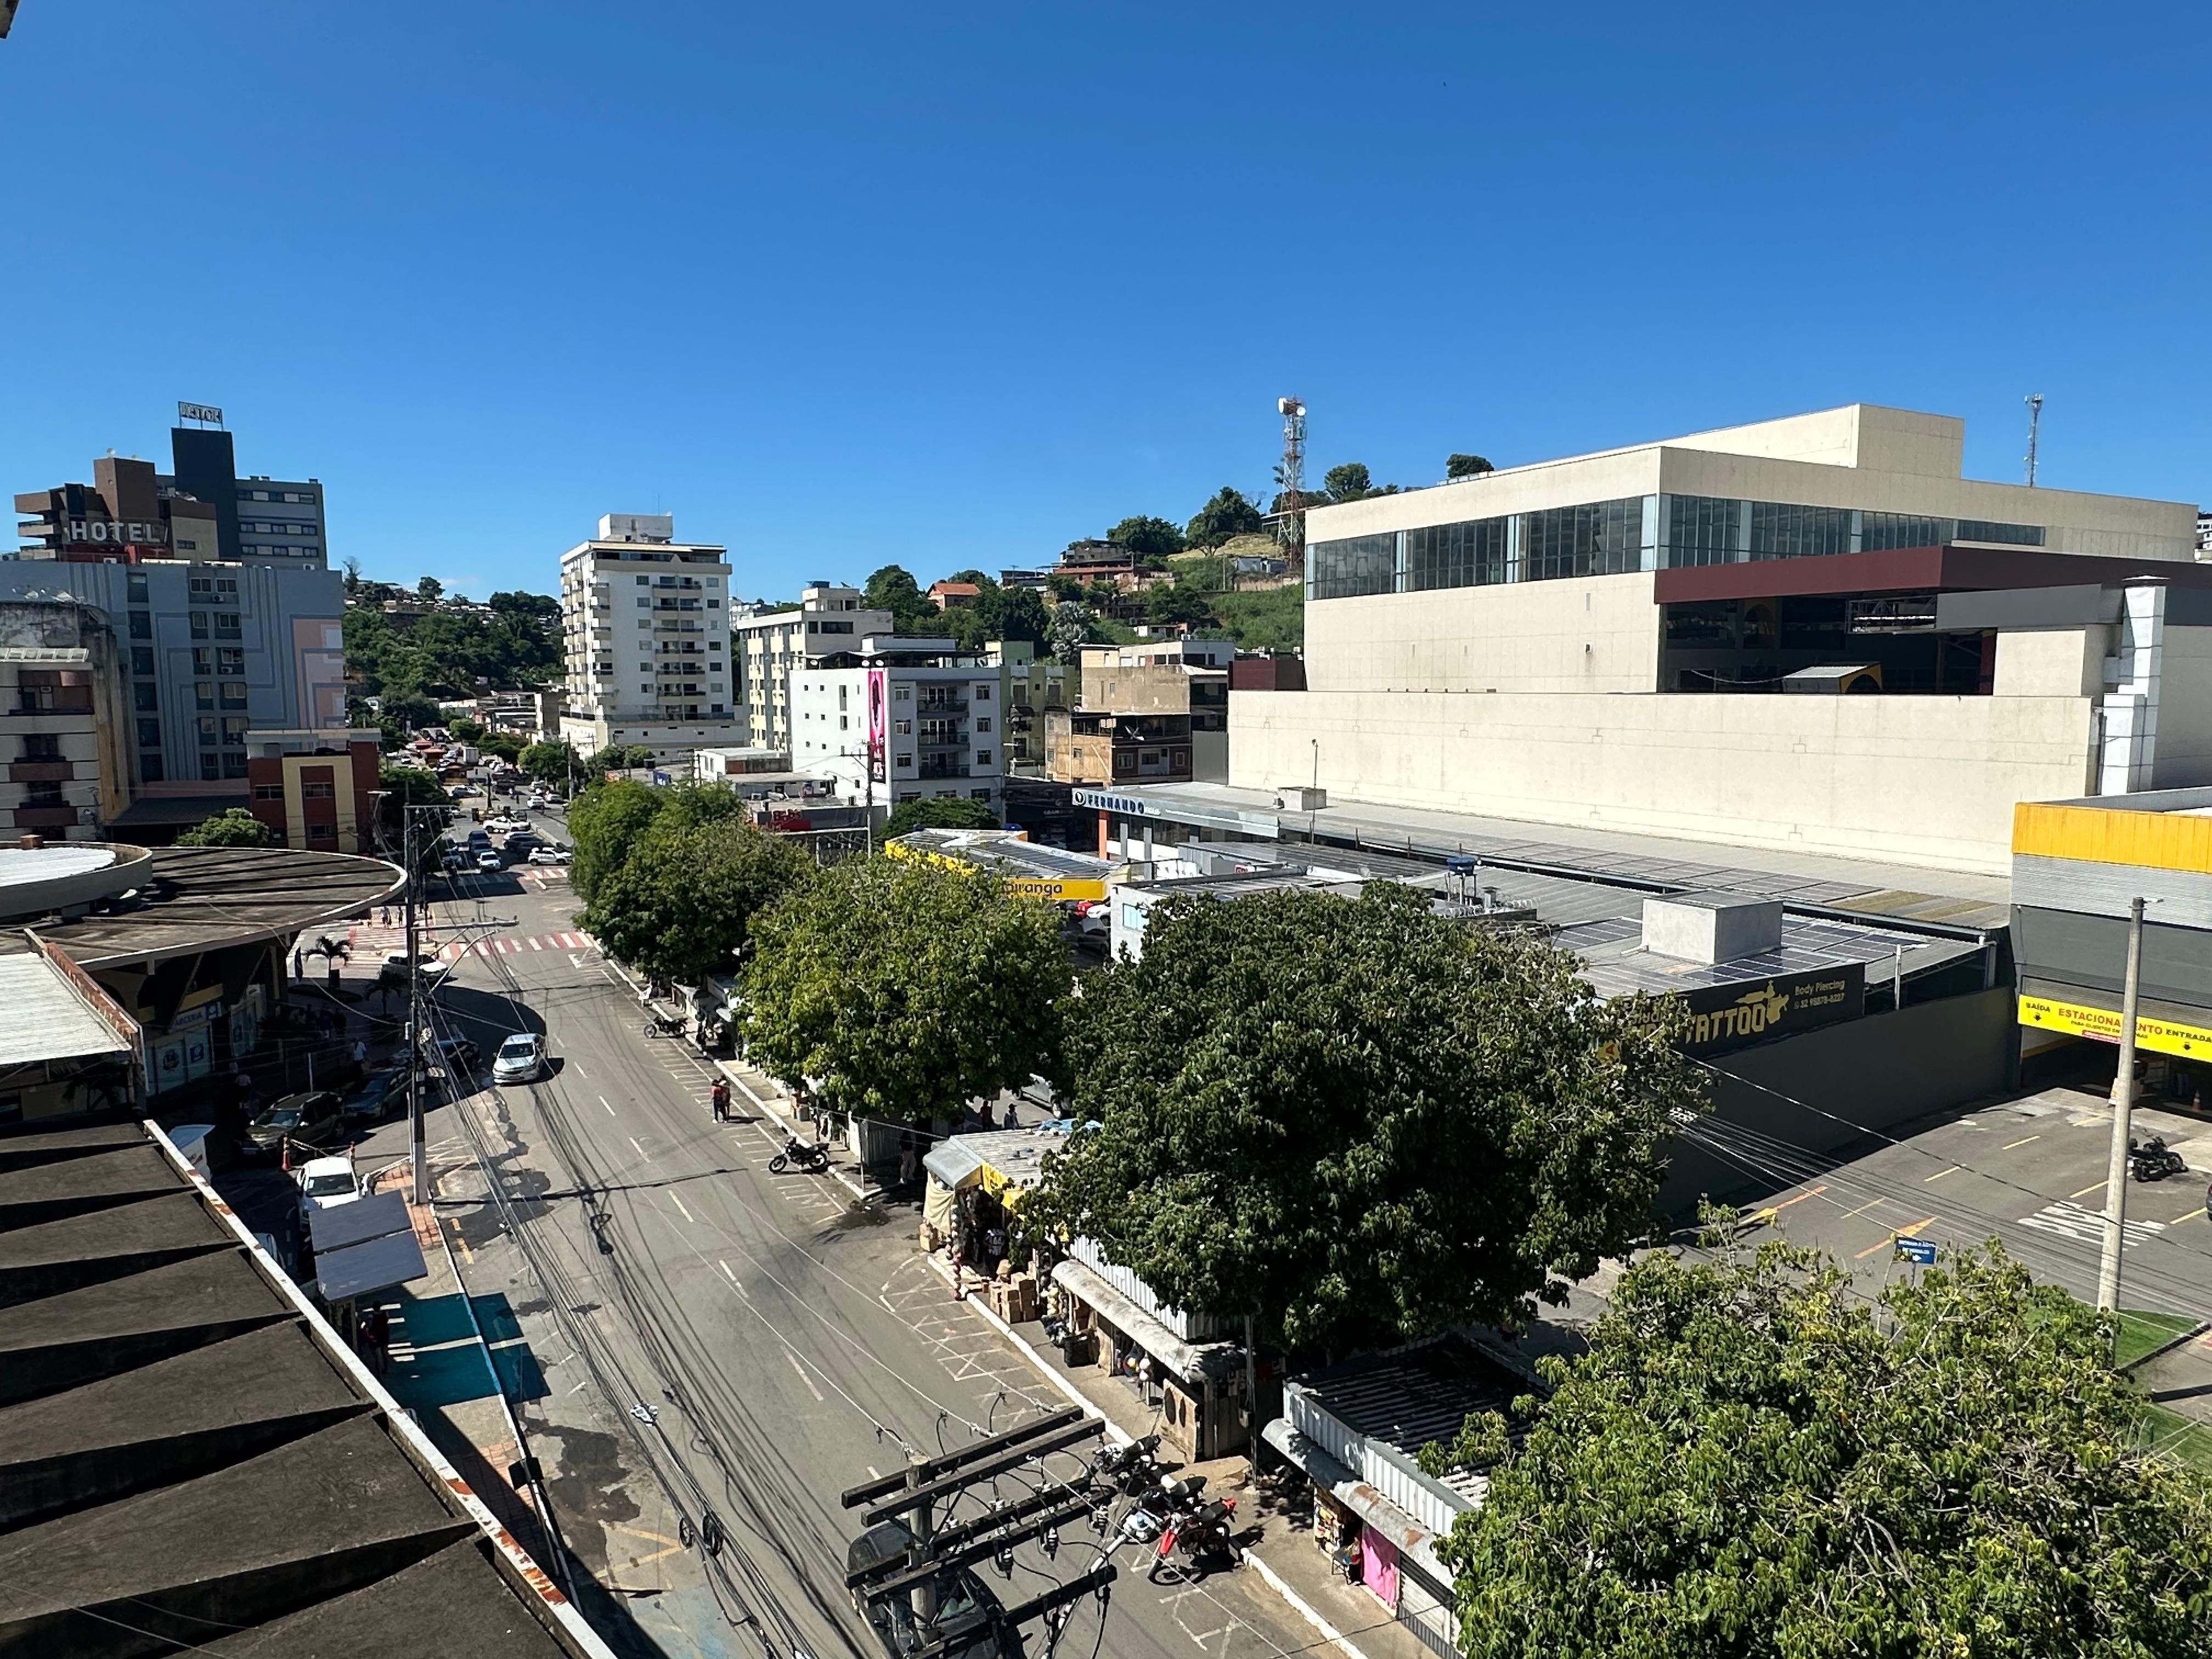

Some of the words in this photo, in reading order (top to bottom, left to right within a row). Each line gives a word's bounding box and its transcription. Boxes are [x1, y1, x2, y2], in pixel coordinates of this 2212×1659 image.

[70, 521, 160, 543] HOTEL
[1088, 795, 1144, 814] FERNANDO
[1795, 983, 1814, 996] Body
[1816, 980, 1846, 992] Piercing
[2025, 1002, 2051, 1013] SAÍDA
[2058, 1008, 2163, 1035] ESTACIONANTO
[2166, 1029, 2212, 1043] ENTRADA
